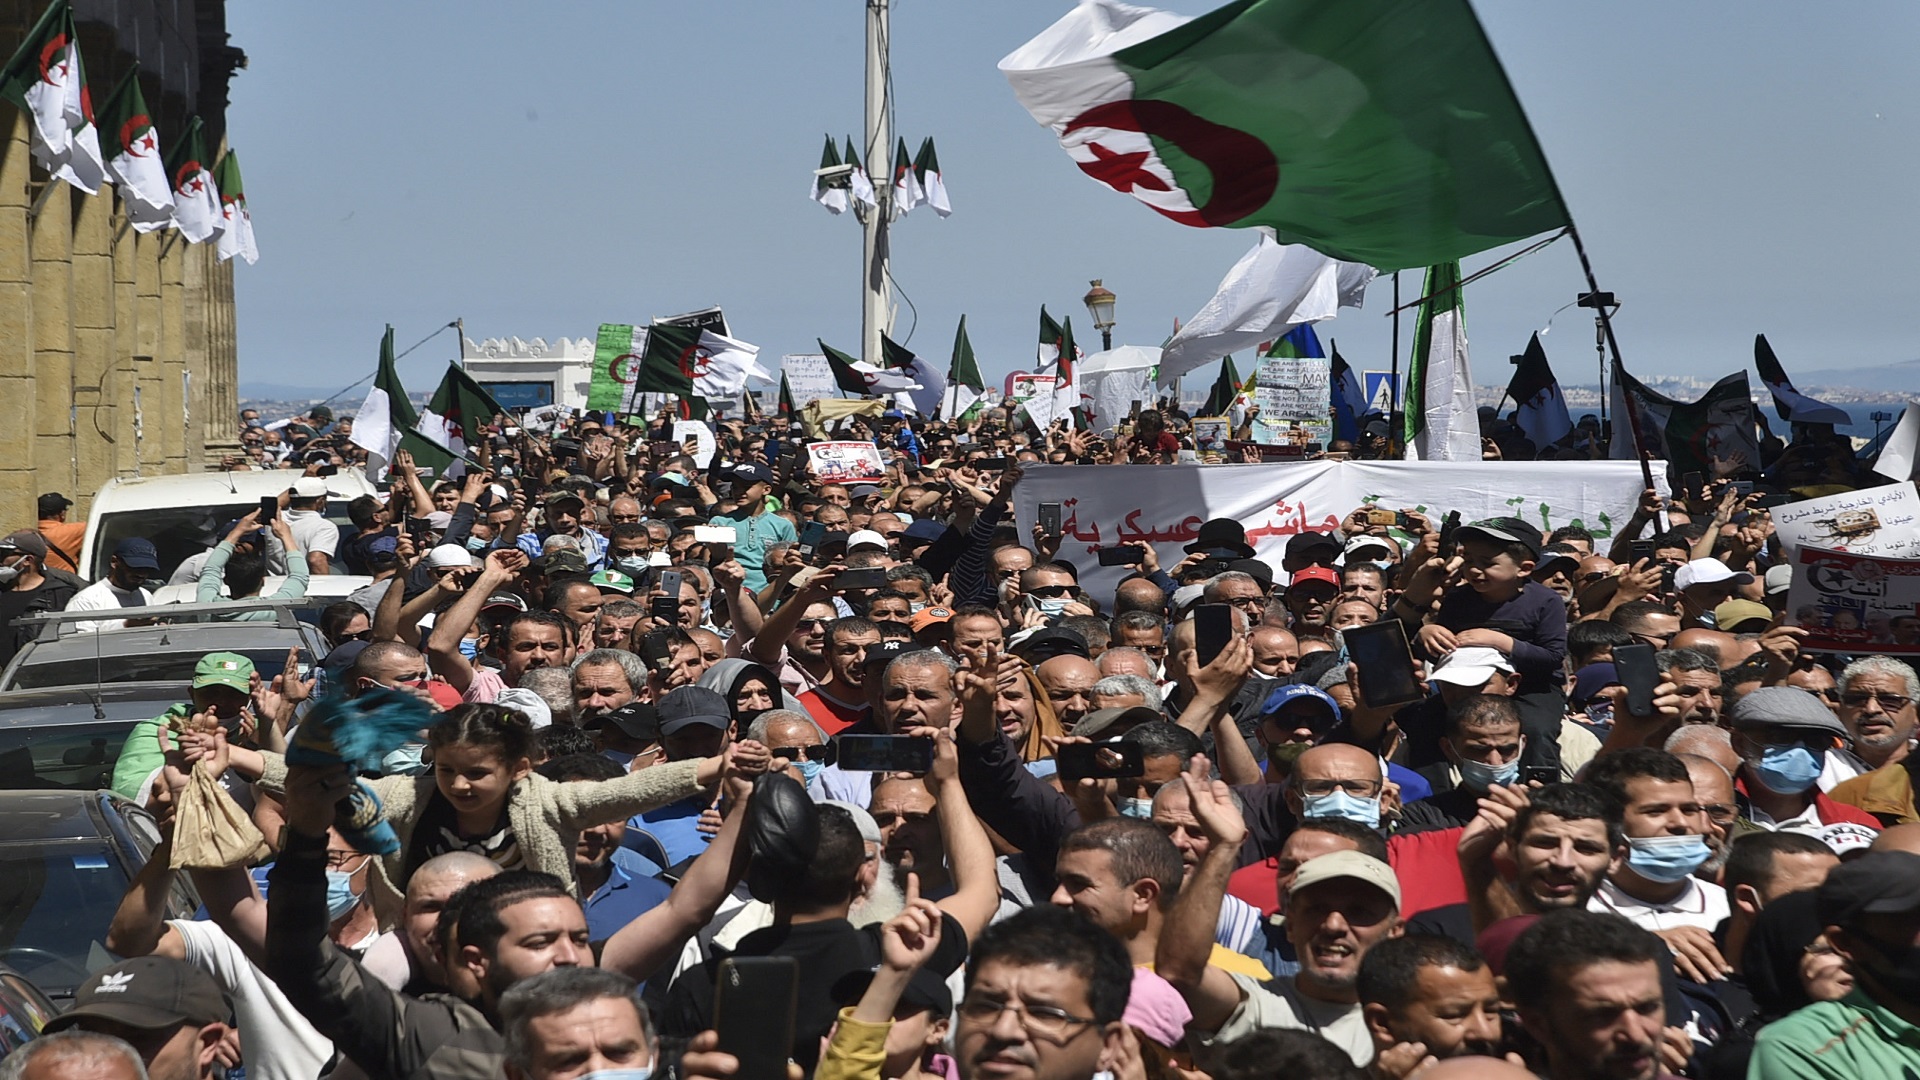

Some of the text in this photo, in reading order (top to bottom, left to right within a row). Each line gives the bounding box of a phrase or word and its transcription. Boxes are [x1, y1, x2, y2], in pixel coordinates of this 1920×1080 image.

[802, 357, 828, 367] Algeria
[1303, 373, 1329, 384] MAK
[1282, 409, 1301, 418] ARE
[1781, 491, 1906, 524] الأيادي الخارجية شريط مشروخ
[1061, 497, 1204, 555] عسكرية
